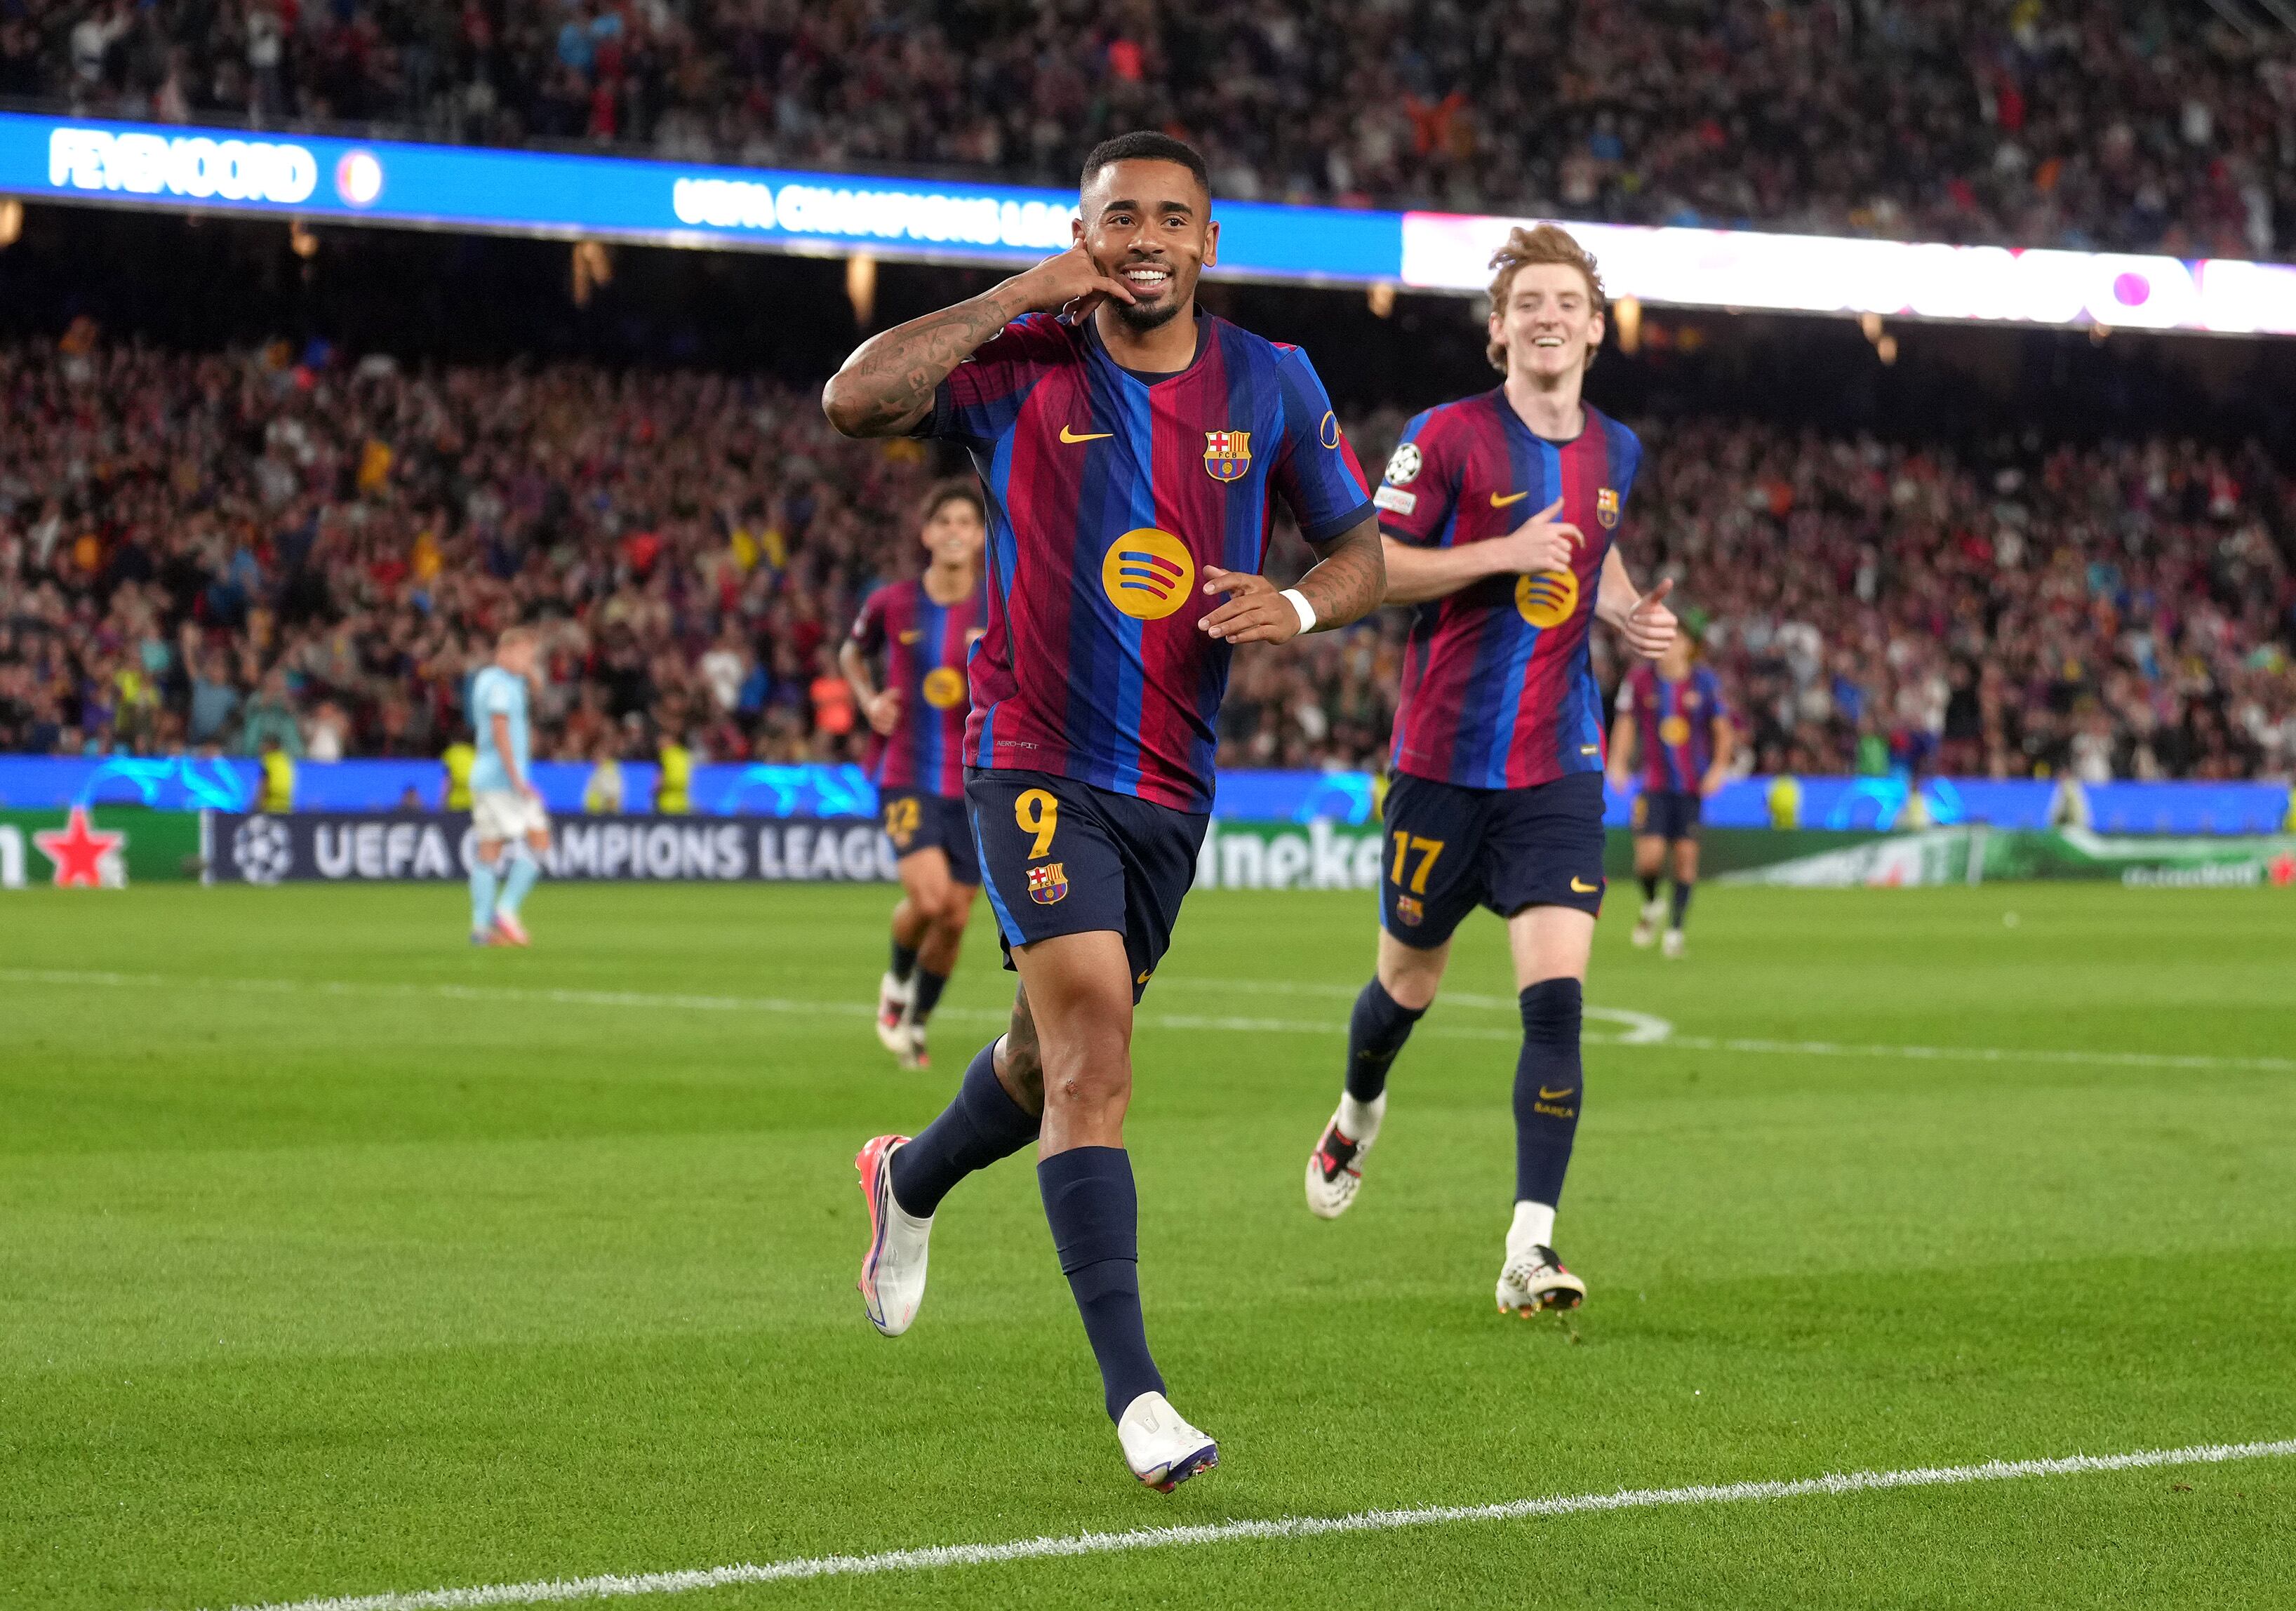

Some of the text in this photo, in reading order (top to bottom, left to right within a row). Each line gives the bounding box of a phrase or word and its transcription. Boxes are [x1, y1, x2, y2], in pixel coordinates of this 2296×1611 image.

[996, 740, 1039, 750] AERO-FIT
[315, 822, 900, 882] UEFA CMPIONS LEAGU
[1015, 788, 1058, 860] 9
[1391, 830, 1445, 895] 17
